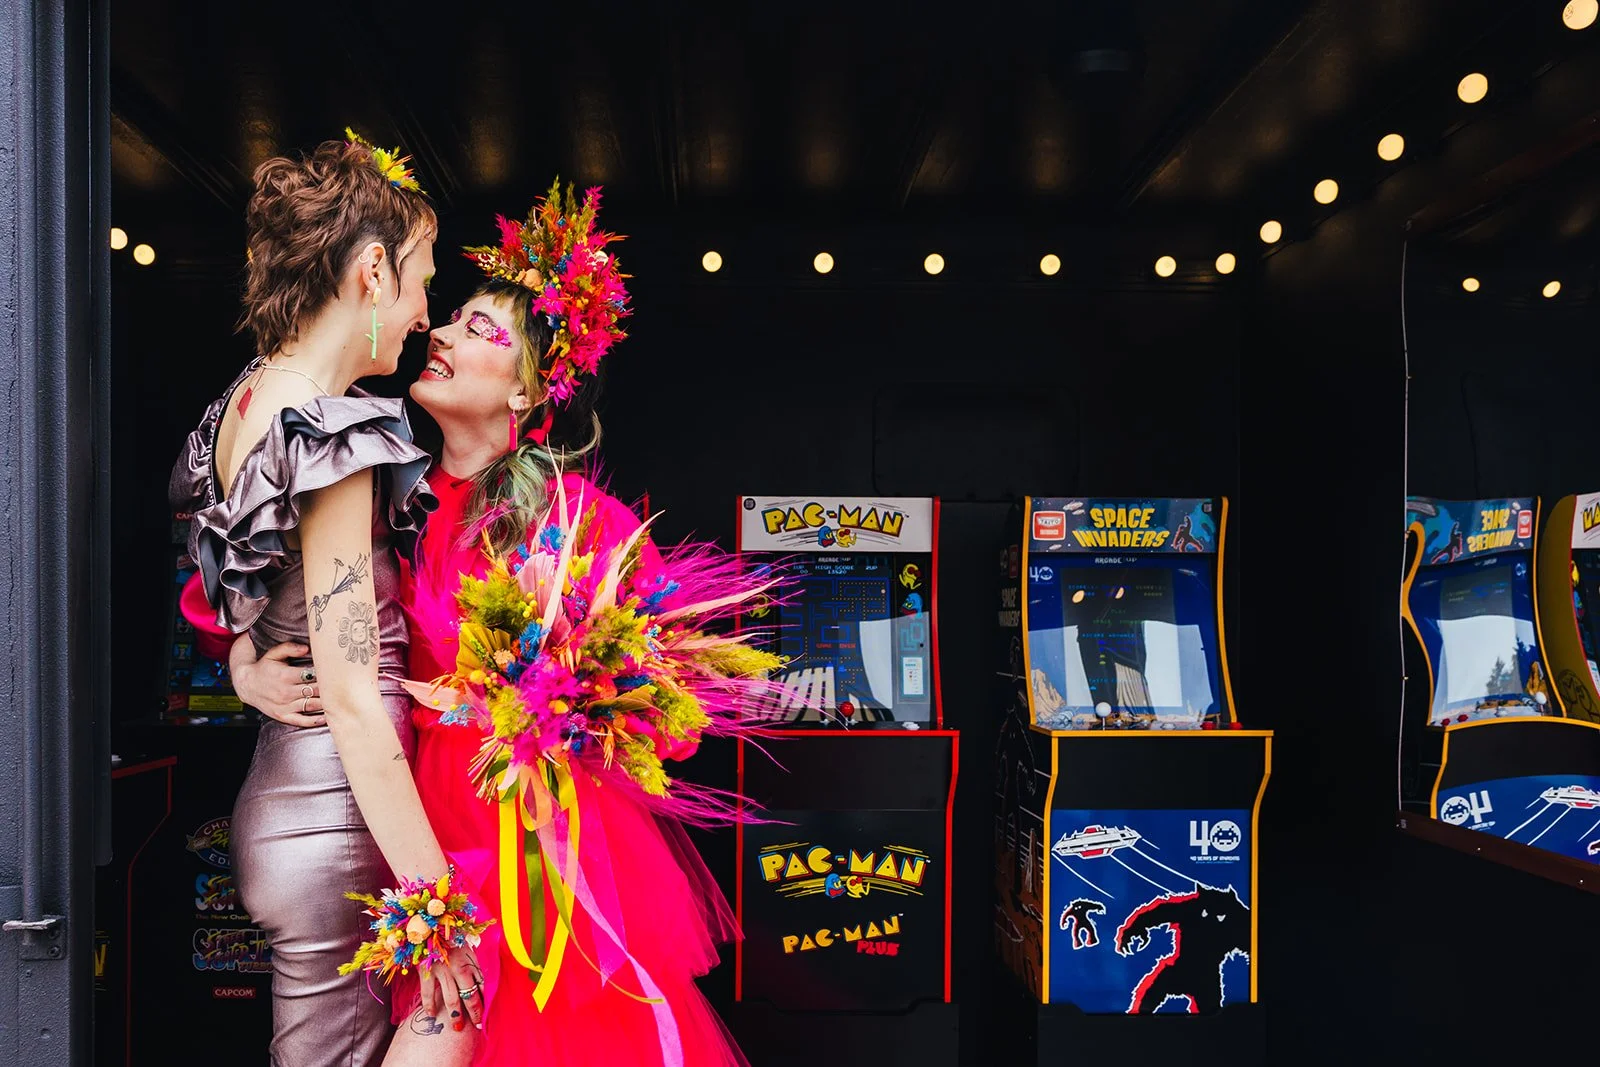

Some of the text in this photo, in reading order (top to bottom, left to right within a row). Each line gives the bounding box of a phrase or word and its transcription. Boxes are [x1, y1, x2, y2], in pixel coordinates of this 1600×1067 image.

[761, 501, 905, 538] PAC-MAN
[1040, 518, 1060, 526] TAITO
[1089, 507, 1156, 529] SPACE
[1071, 530, 1171, 548] INVADERS
[1189, 819, 1242, 856] 40
[756, 844, 928, 887] PAC-MAN
[781, 915, 901, 955] PAC-MAN
[855, 939, 901, 957] PLUS
[213, 988, 254, 997] CAPCOM
